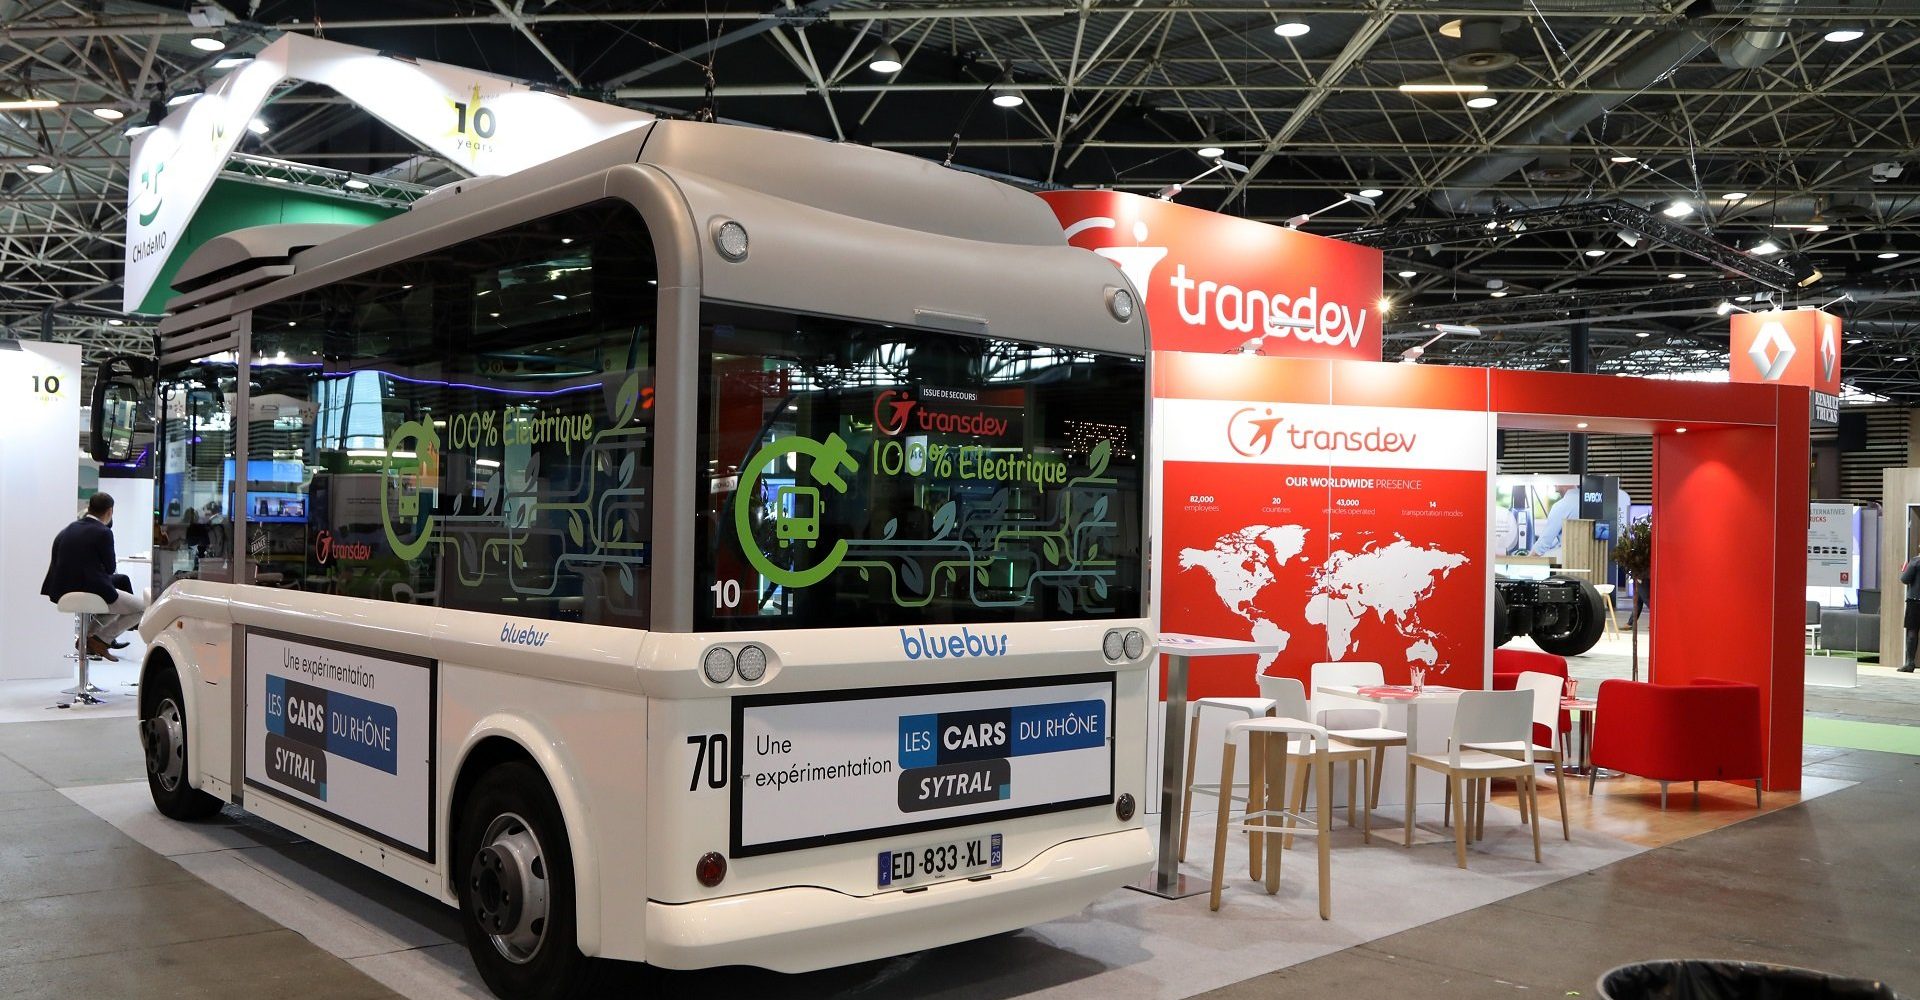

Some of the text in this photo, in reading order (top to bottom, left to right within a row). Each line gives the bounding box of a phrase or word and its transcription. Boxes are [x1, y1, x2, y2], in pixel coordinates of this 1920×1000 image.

[455, 101, 496, 139] 10
[457, 139, 493, 153] years
[1170, 263, 1367, 348] transdev
[32, 375, 60, 394] 10
[923, 388, 940, 397] ISSUE
[940, 390, 949, 398] DE
[1815, 391, 1840, 410] RENAULT
[917, 407, 1008, 437] transdev
[1816, 406, 1838, 423] TRUCKS
[447, 408, 593, 456] 100% Electrique
[1287, 424, 1417, 453] transdev
[873, 439, 1067, 494] 100% Electrique
[1285, 476, 1422, 490] OUR WORLDWIDE PRESENCE
[1184, 504, 1219, 513] employees
[1190, 495, 1214, 504] 82,000
[1272, 497, 1282, 505] 20
[1322, 507, 1376, 515] vehicles operated
[1336, 499, 1360, 507] 43,000
[1402, 509, 1463, 517] transportation modes
[332, 541, 371, 560] transdev
[710, 579, 741, 609] 10
[500, 622, 550, 647] bluebus
[900, 626, 1008, 660] bluebus
[283, 647, 375, 690] Une expérimentation
[268, 693, 391, 752] LES CARS DU RHÔNE
[905, 712, 1098, 752] LES CARS DU RHÔNE
[756, 734, 792, 756] Une
[275, 747, 316, 784] SYTRAL
[687, 733, 728, 792] 70
[755, 757, 892, 791] expérimentation
[918, 770, 993, 800] SYTRAL
[991, 851, 1001, 864] 29
[882, 872, 887, 880] F
